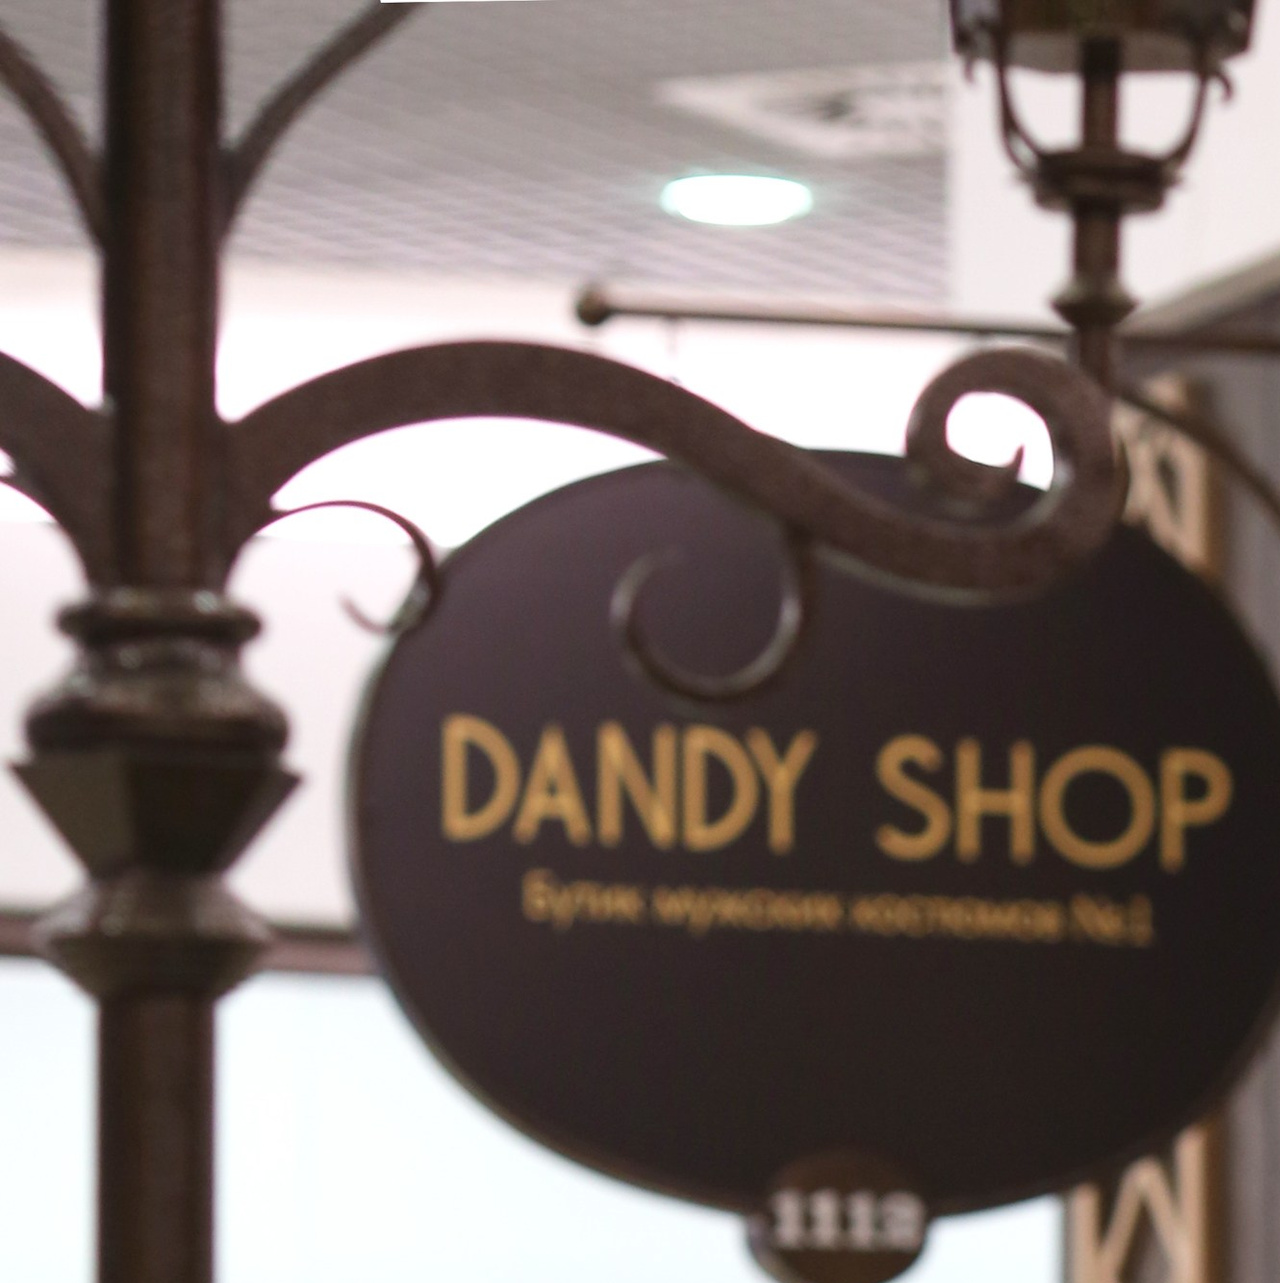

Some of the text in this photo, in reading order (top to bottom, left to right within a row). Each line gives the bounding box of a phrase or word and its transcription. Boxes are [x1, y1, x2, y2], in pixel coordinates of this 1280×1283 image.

[439, 712, 1234, 872] DANDY SHOP
[522, 868, 646, 933] Бутик
